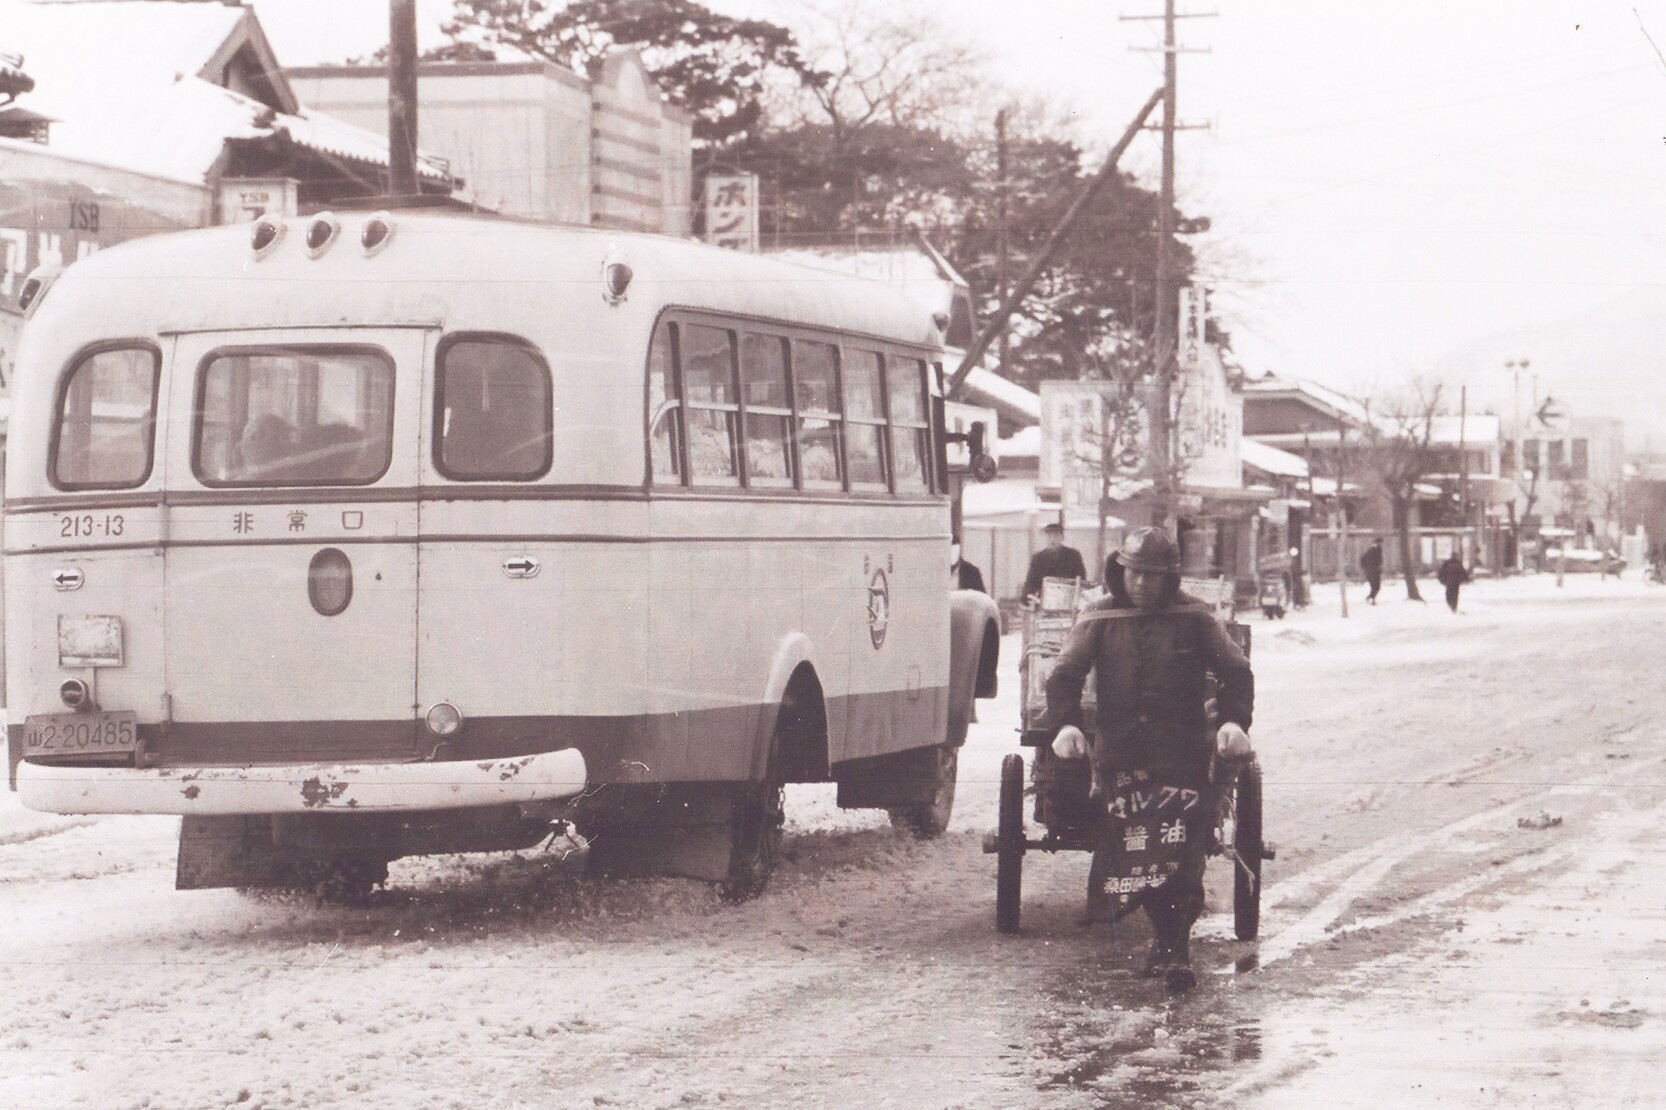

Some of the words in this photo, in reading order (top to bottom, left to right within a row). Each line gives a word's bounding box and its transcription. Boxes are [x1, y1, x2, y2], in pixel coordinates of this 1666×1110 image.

[61, 515, 125, 538] 213-13
[232, 510, 364, 534] 非常口
